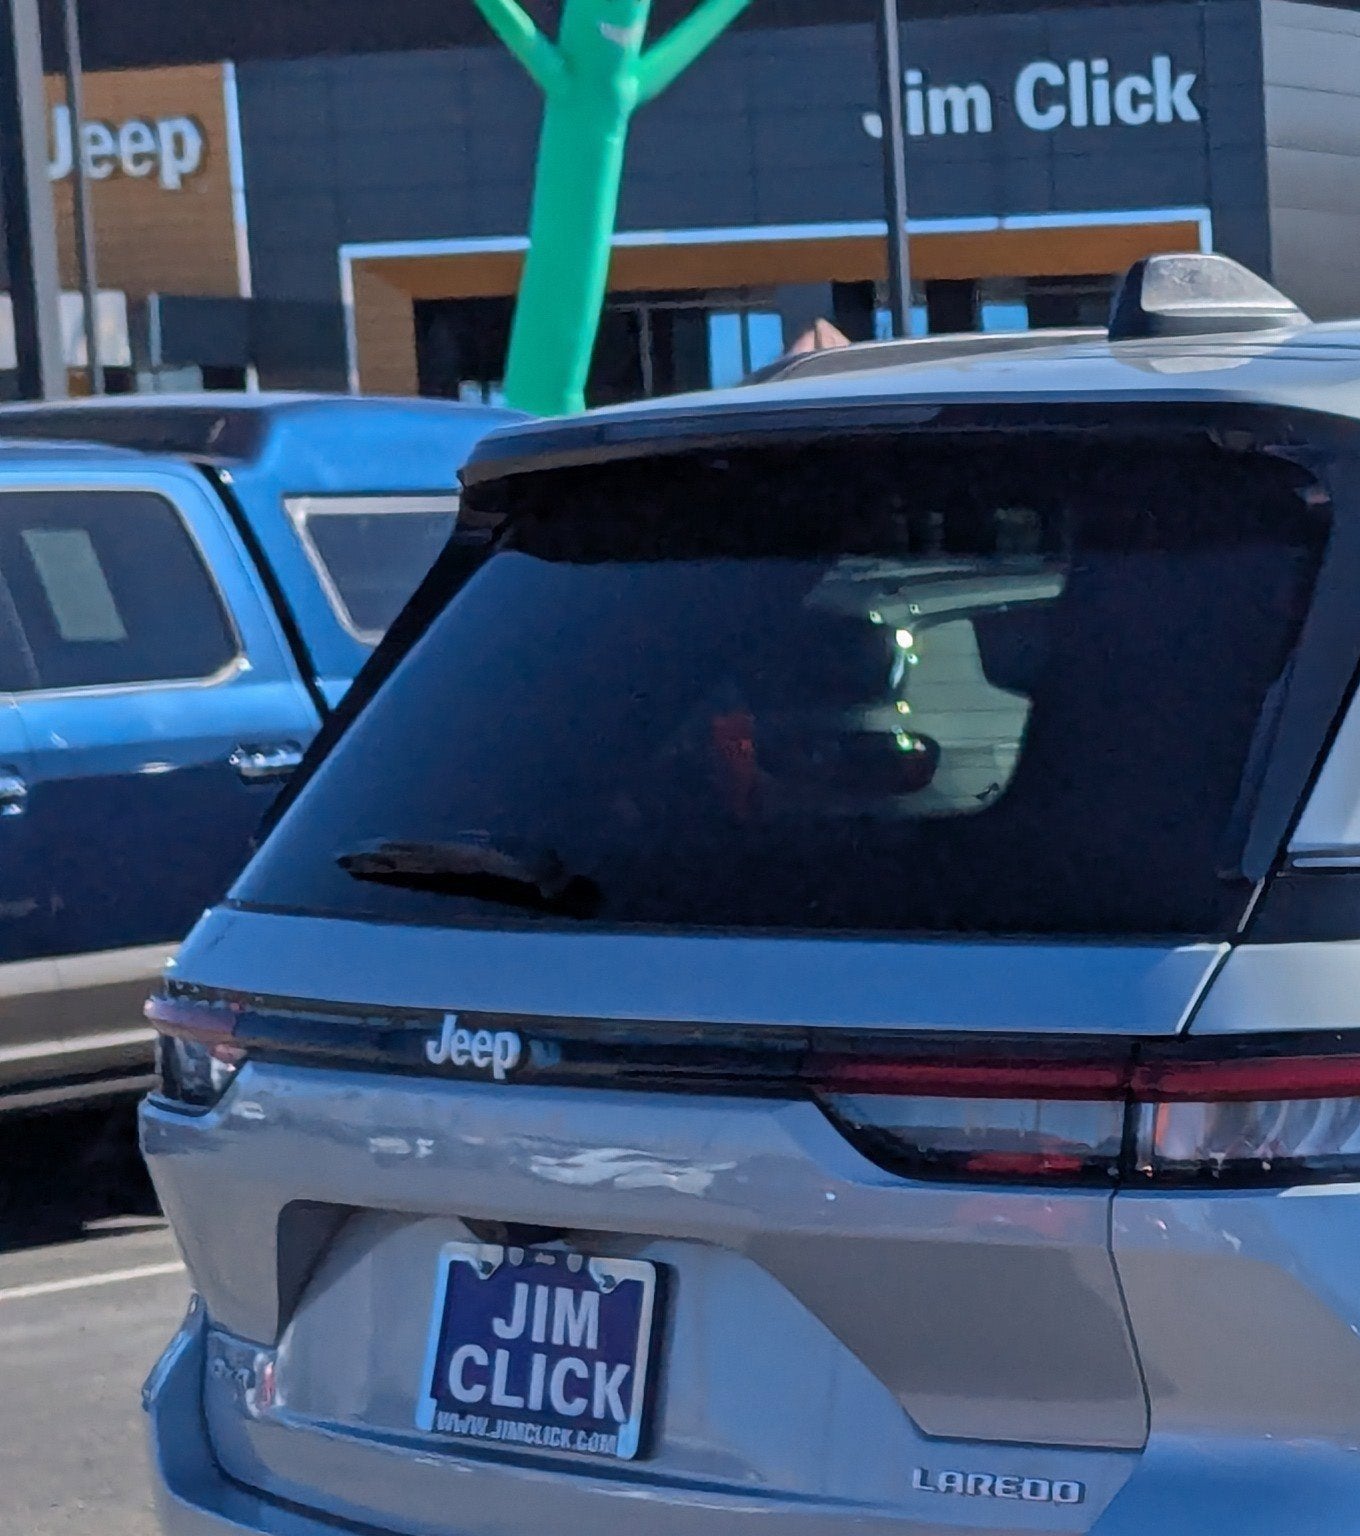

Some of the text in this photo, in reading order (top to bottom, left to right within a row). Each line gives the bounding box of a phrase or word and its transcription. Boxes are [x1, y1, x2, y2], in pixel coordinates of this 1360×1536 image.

[862, 54, 1200, 138] im Click
[47, 104, 202, 190] Jeep
[426, 1012, 521, 1079] Jeep
[492, 1282, 600, 1350] JIM
[449, 1344, 631, 1424] CLICK
[436, 1411, 618, 1454] WWW.JIMCLICK.COM
[912, 1467, 1083, 1504] LAREDO
